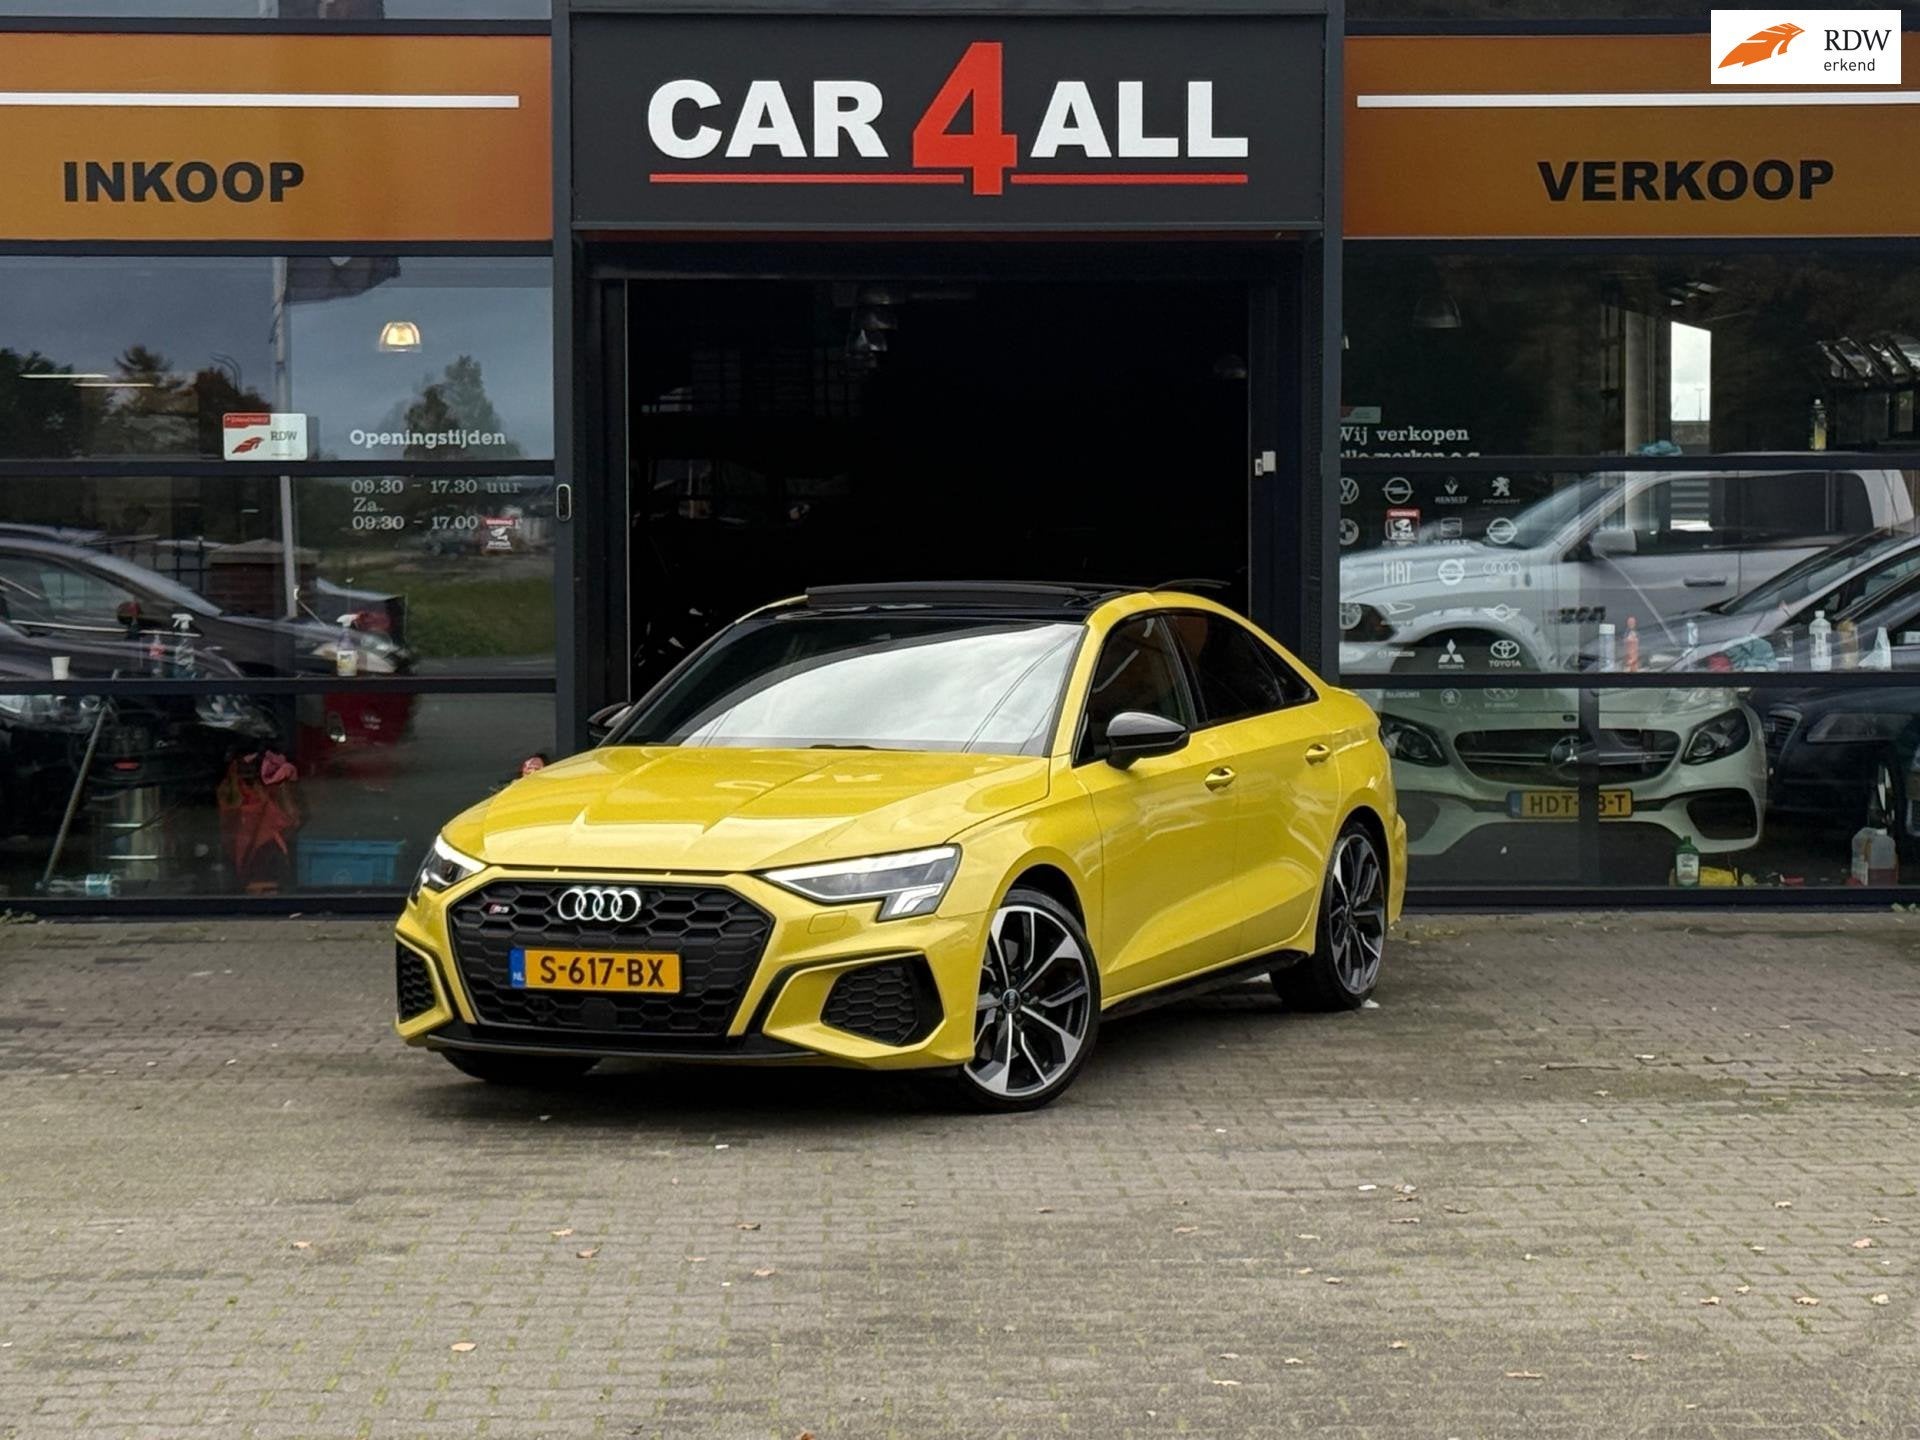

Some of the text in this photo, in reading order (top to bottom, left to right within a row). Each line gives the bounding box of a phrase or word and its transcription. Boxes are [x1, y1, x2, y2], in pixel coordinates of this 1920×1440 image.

[647, 41, 1249, 195] CAR 4 ALL
[63, 161, 305, 203] INKOOP
[1537, 158, 1835, 202] VERKOOP
[270, 431, 298, 441] RDW
[350, 429, 506, 449] Openingstijden
[1340, 425, 1470, 446] Wij verkopen
[351, 480, 404, 494] 09.30
[430, 480, 478, 494] 17.30
[486, 481, 522, 494] uur
[353, 498, 384, 512] Za.
[352, 516, 405, 530] 09.30
[431, 516, 478, 530] 17.00
[1384, 560, 1413, 584] FIAT
[1489, 660, 1521, 668] TOYOTA
[1530, 794, 1625, 814] HDT--T
[540, 955, 664, 987] S-617-BX
